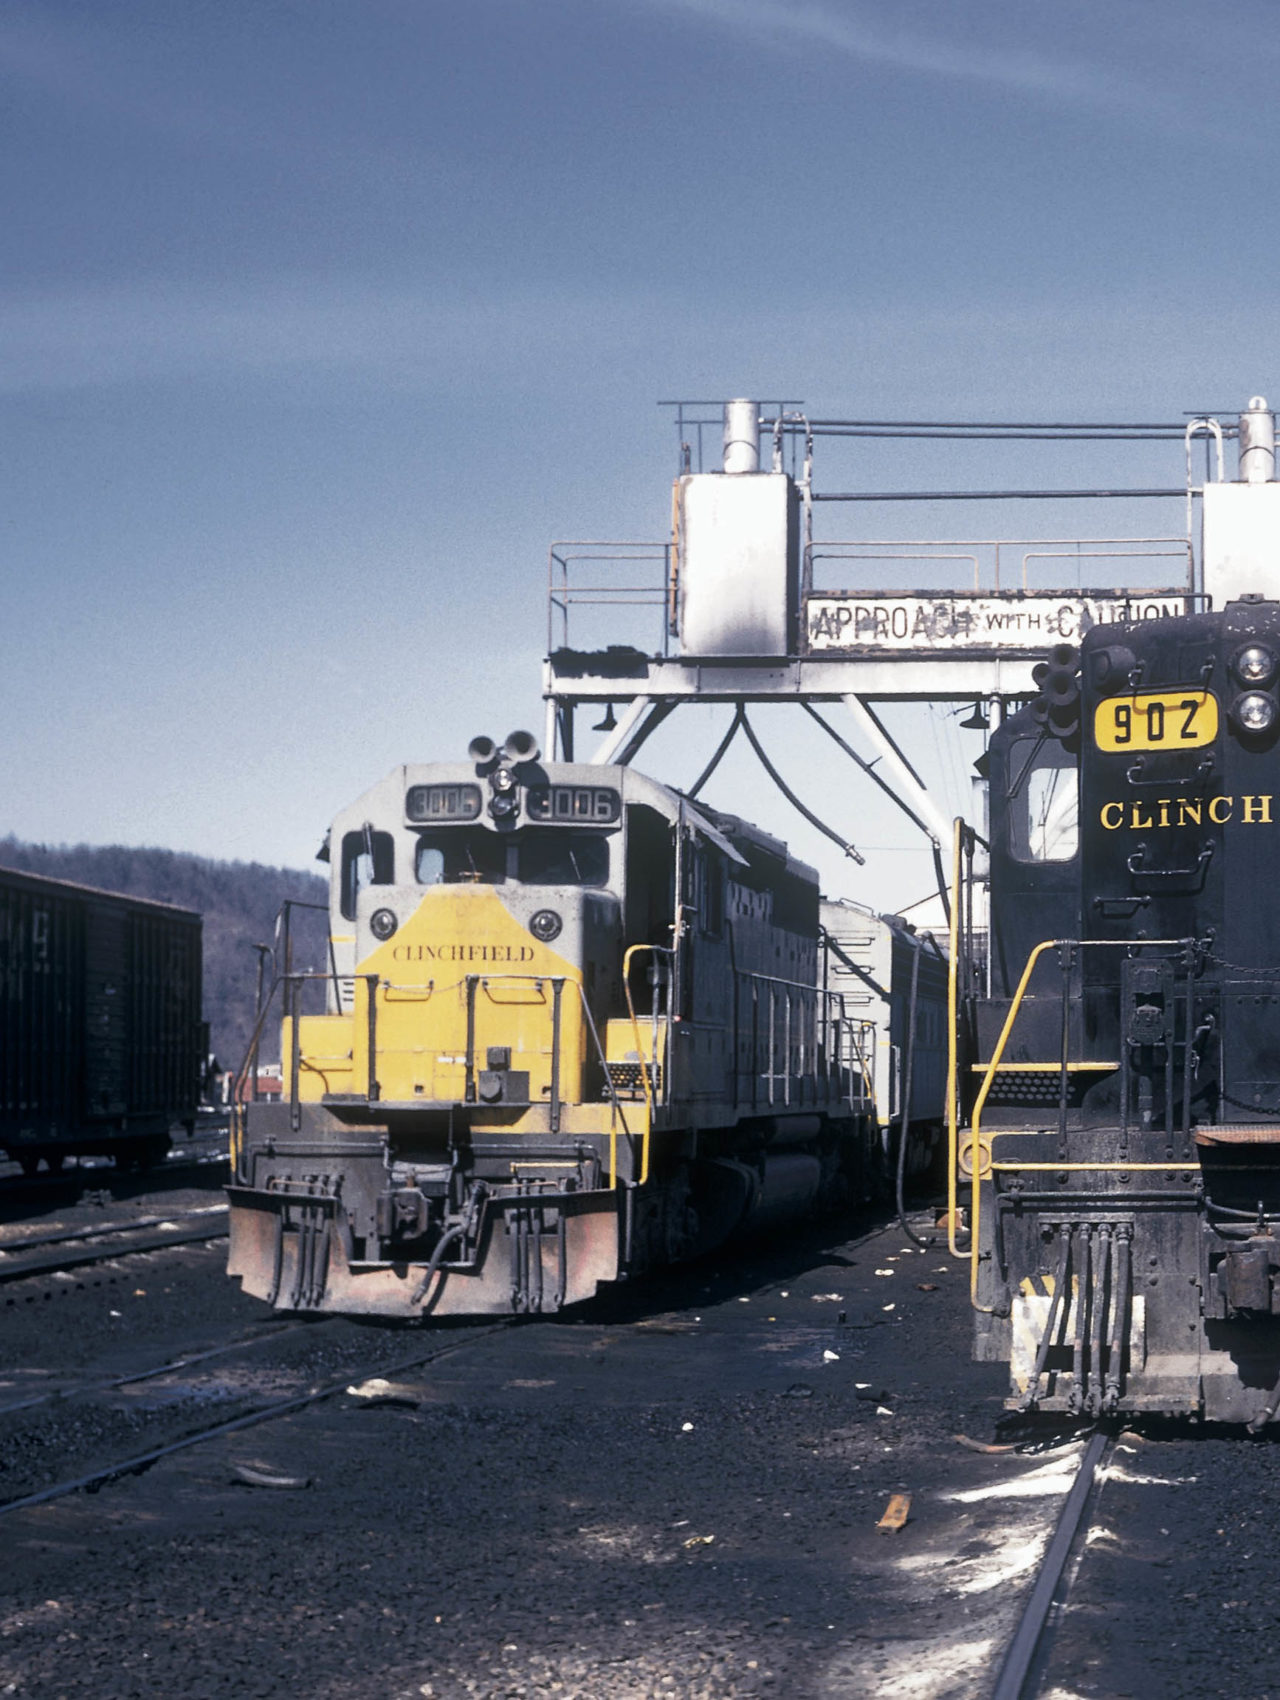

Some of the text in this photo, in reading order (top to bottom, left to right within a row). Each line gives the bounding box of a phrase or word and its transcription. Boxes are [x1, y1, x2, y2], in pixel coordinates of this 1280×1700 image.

[986, 613, 1041, 631] WITH
[1115, 699, 1199, 744] 902
[413, 789, 478, 817] 3006
[536, 789, 612, 819] 3006
[392, 945, 534, 962] CLINCHFIELD
